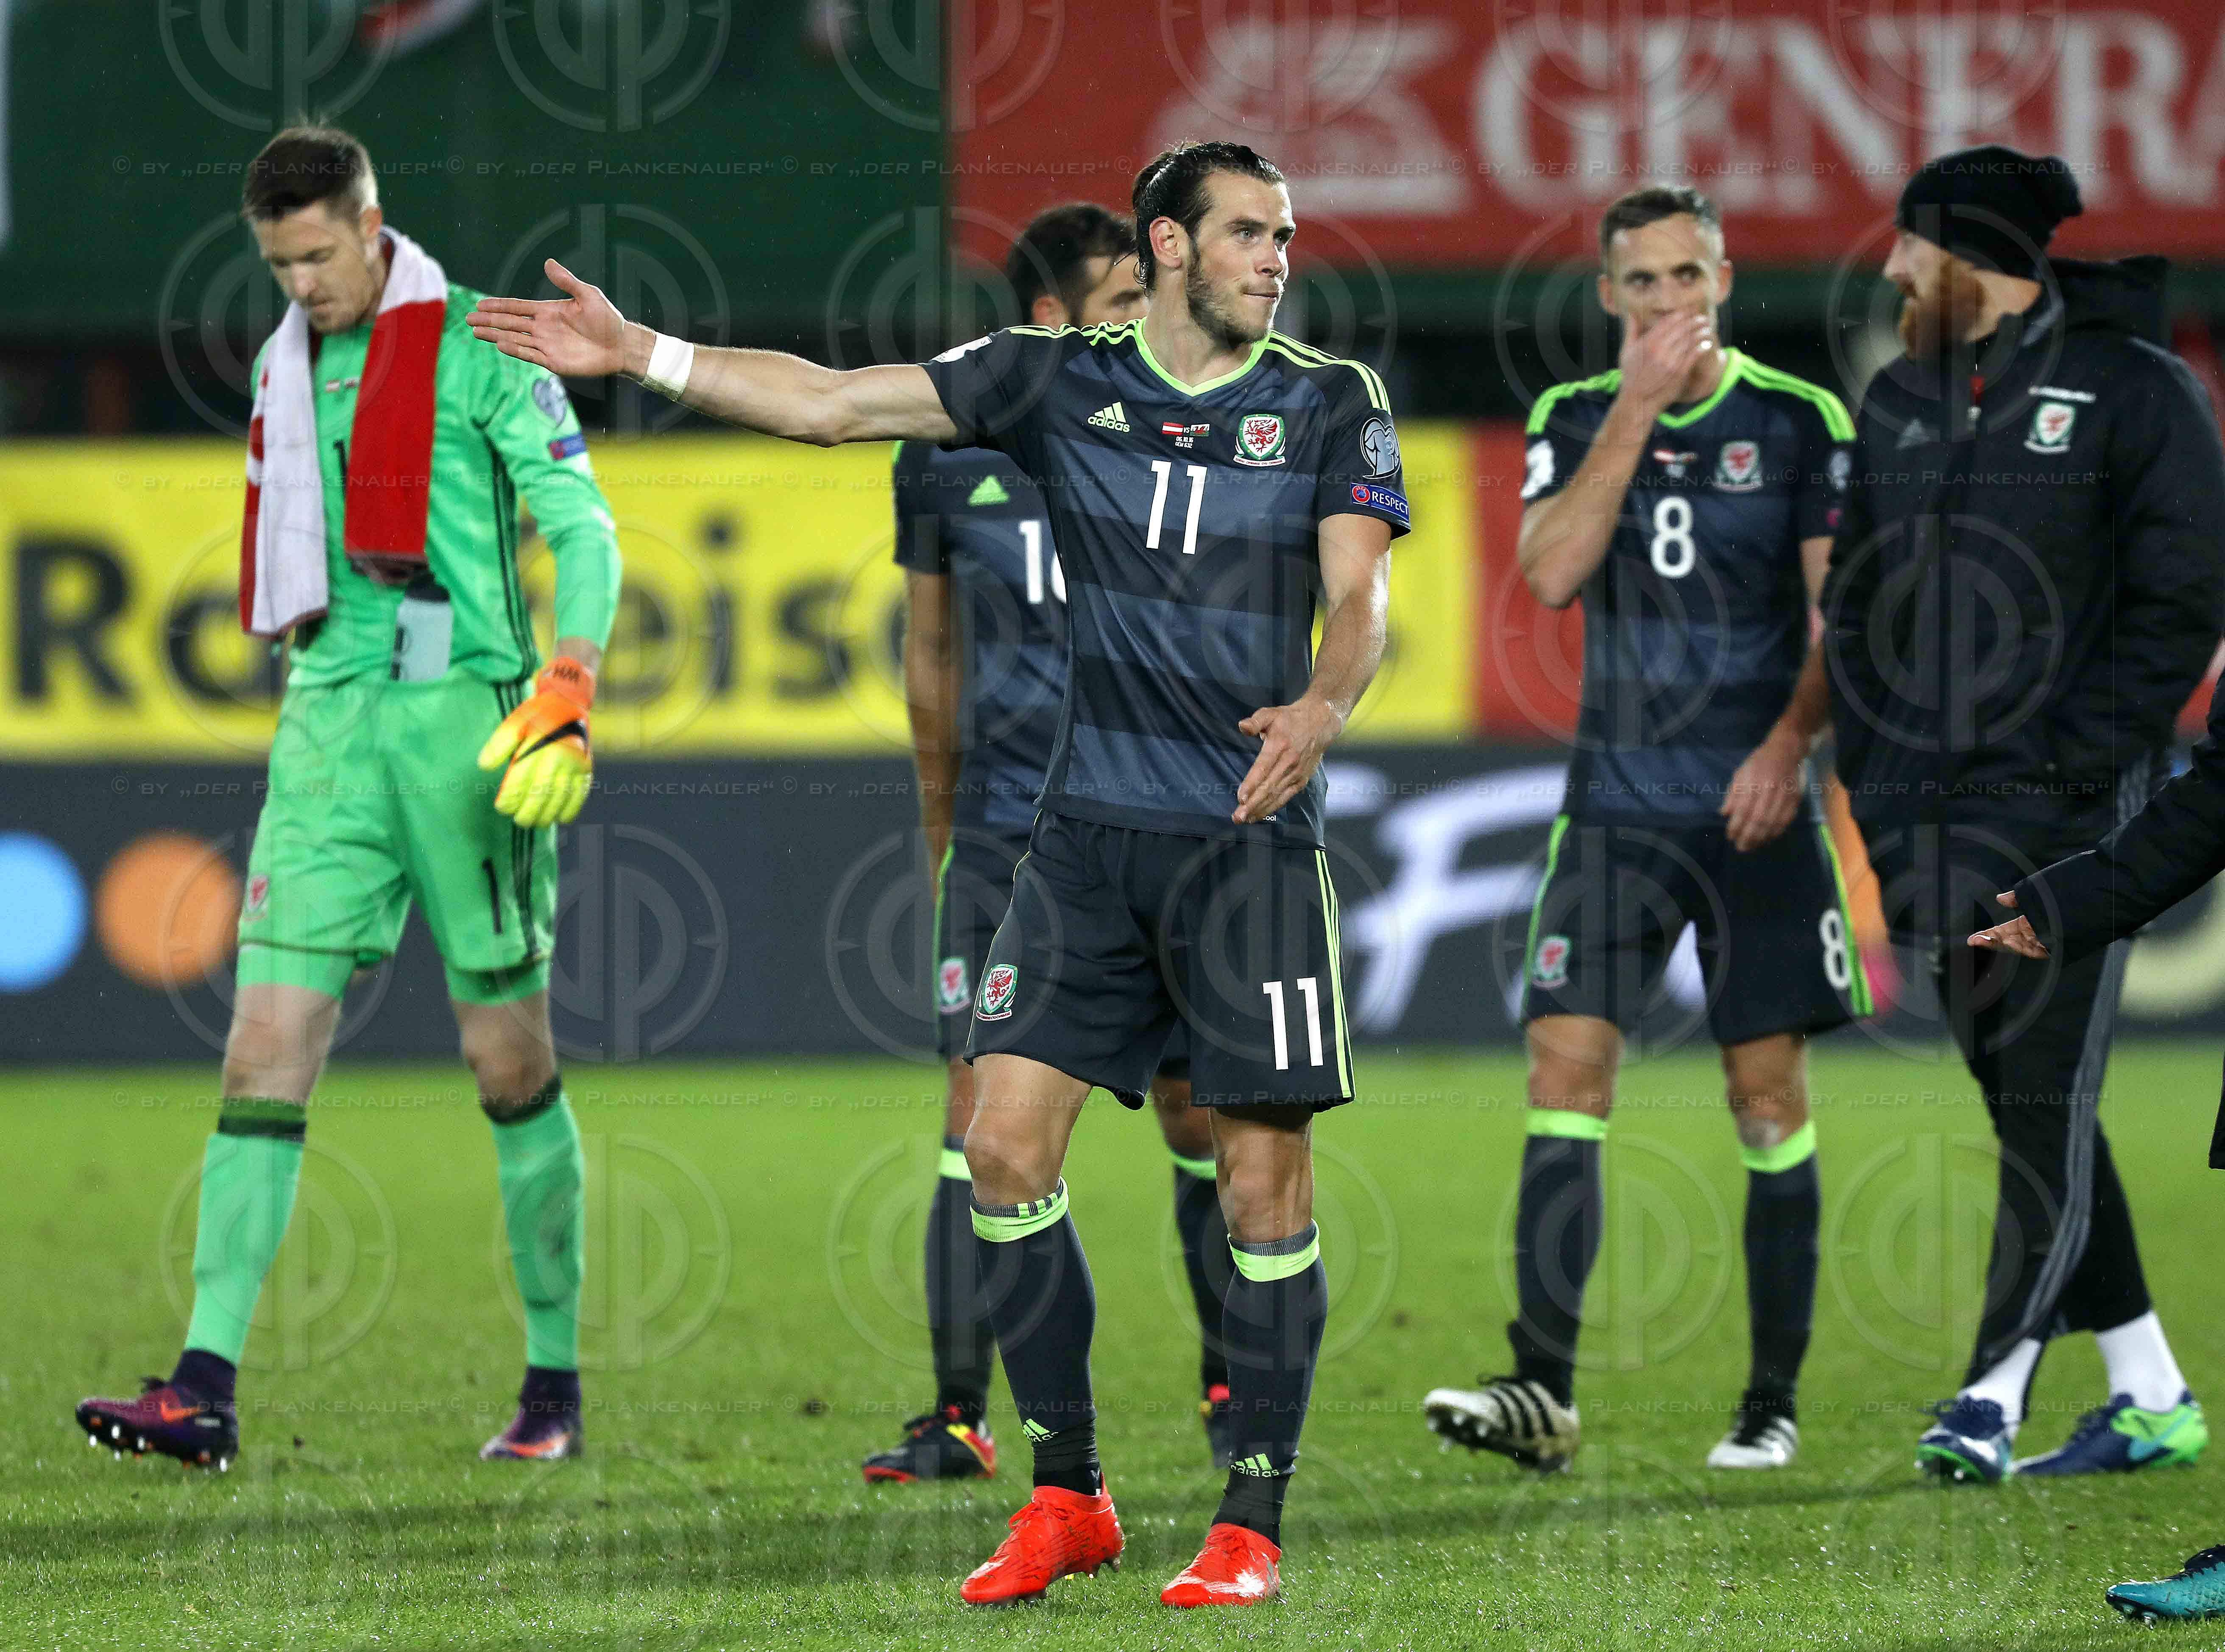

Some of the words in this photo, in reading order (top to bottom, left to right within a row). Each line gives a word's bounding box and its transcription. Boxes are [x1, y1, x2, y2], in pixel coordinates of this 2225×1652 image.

[1087, 416, 1130, 433] adidas
[1146, 460, 1207, 555] 11
[1372, 491, 1408, 516] RESPECT
[1651, 495, 1696, 578] 8
[1019, 520, 1068, 604] 1
[481, 857, 504, 935] 1
[1819, 907, 1851, 991] 8
[1262, 977, 1324, 1070] 11
[1231, 1465, 1279, 1478] adidas
